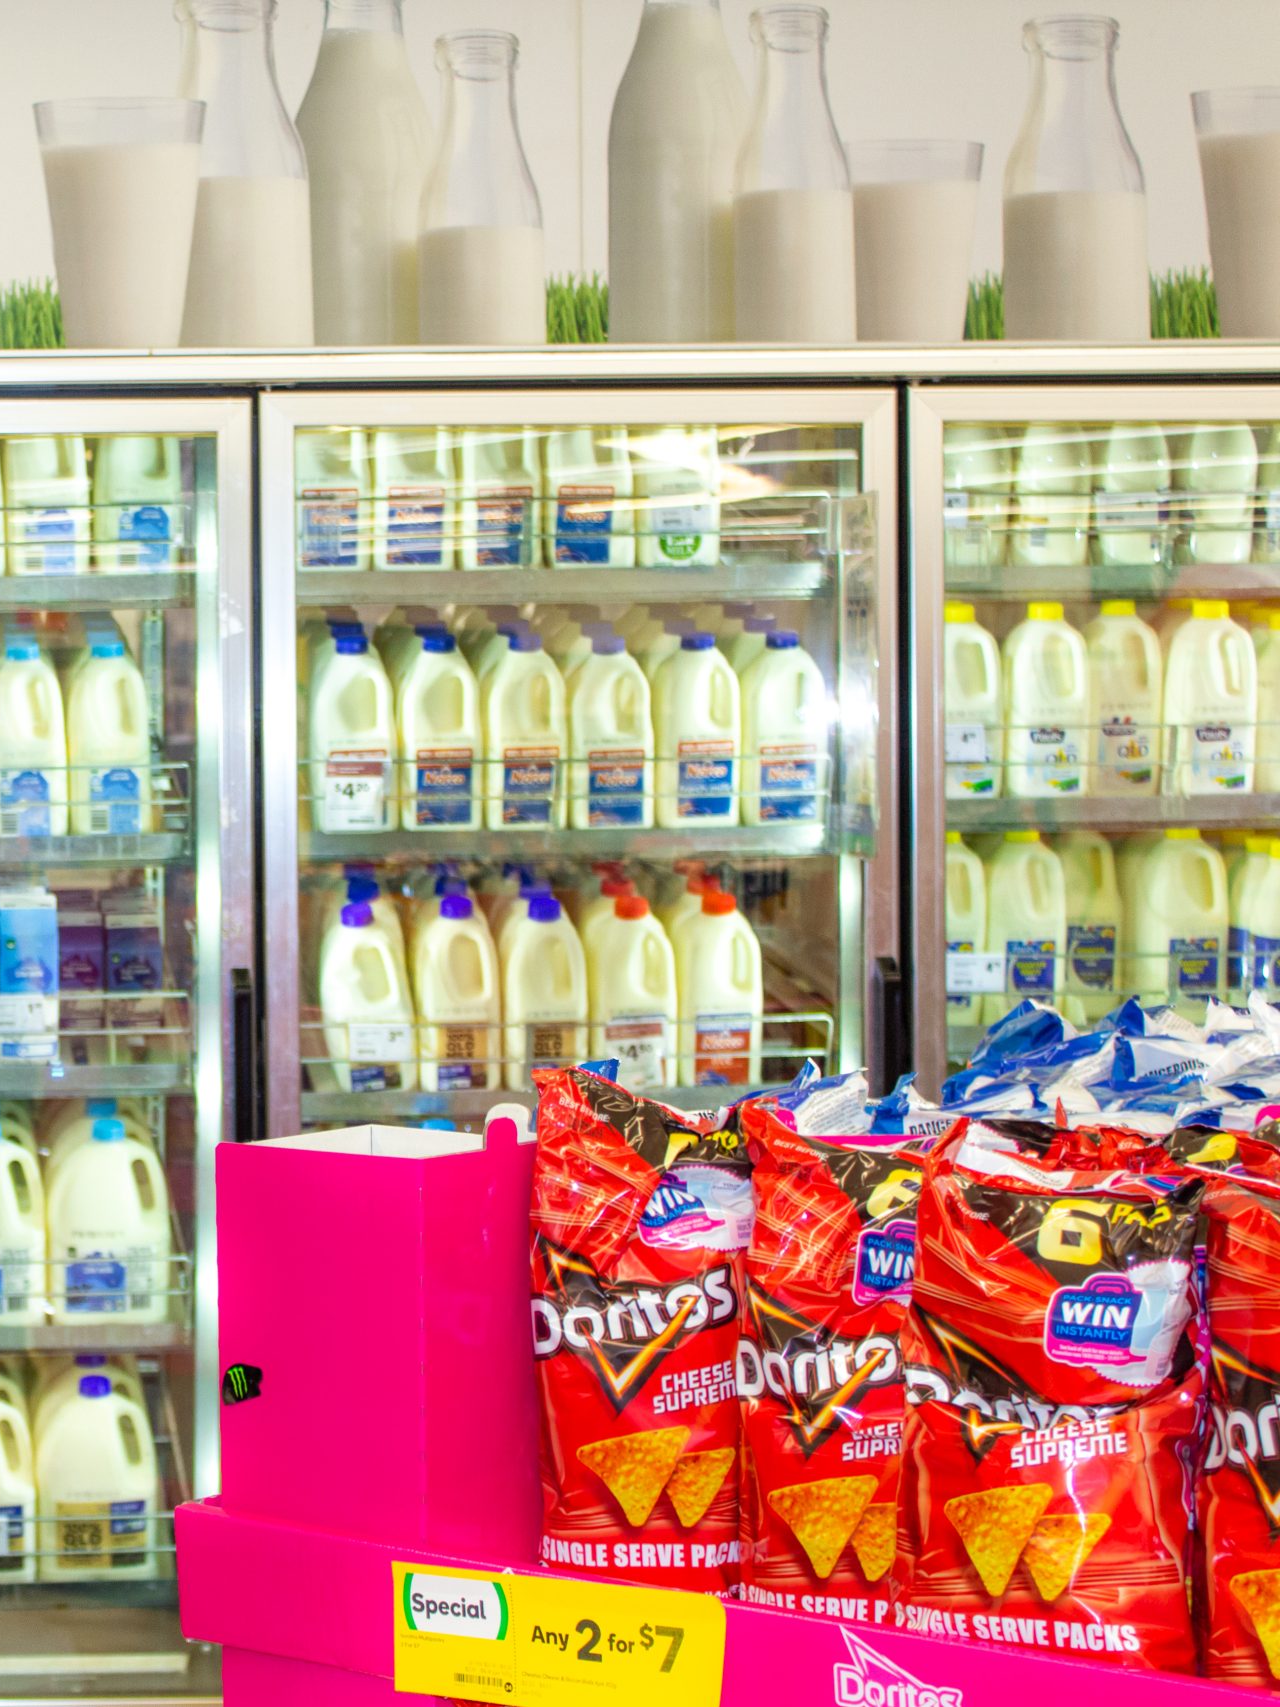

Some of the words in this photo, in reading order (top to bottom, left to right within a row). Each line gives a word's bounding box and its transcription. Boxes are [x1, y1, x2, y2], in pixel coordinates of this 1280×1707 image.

[558, 1096, 580, 1112] BEST
[773, 1138, 795, 1153] BEST
[644, 1186, 696, 1218] WIN
[895, 1243, 913, 1253] SNA
[1038, 1199, 1111, 1266] 6
[868, 1247, 914, 1279] WIN
[531, 1267, 736, 1357] Doritos
[1061, 1301, 1131, 1329] WIN
[1055, 1325, 1129, 1341] INSTANTLY
[661, 1360, 734, 1394] CHEESE
[736, 1337, 903, 1397] Dorito
[652, 1379, 737, 1414] SUPREM
[1020, 1419, 1113, 1444] CHEESE
[842, 1438, 904, 1462] SUPR
[1010, 1433, 1128, 1468] SUPREME
[542, 1535, 609, 1568] SINGLE
[618, 1542, 685, 1568] SERVE
[690, 1540, 740, 1568] PACK
[411, 1592, 487, 1620] Special
[748, 1585, 796, 1610] SINGLE
[801, 1594, 868, 1622] SERVE
[905, 1605, 970, 1637] SINGLE
[973, 1614, 1050, 1648] SERVE
[1054, 1621, 1140, 1652] PACKS
[531, 1625, 569, 1651] Any
[575, 1618, 603, 1663] 2
[607, 1633, 635, 1654] for
[639, 1622, 685, 1674] $7
